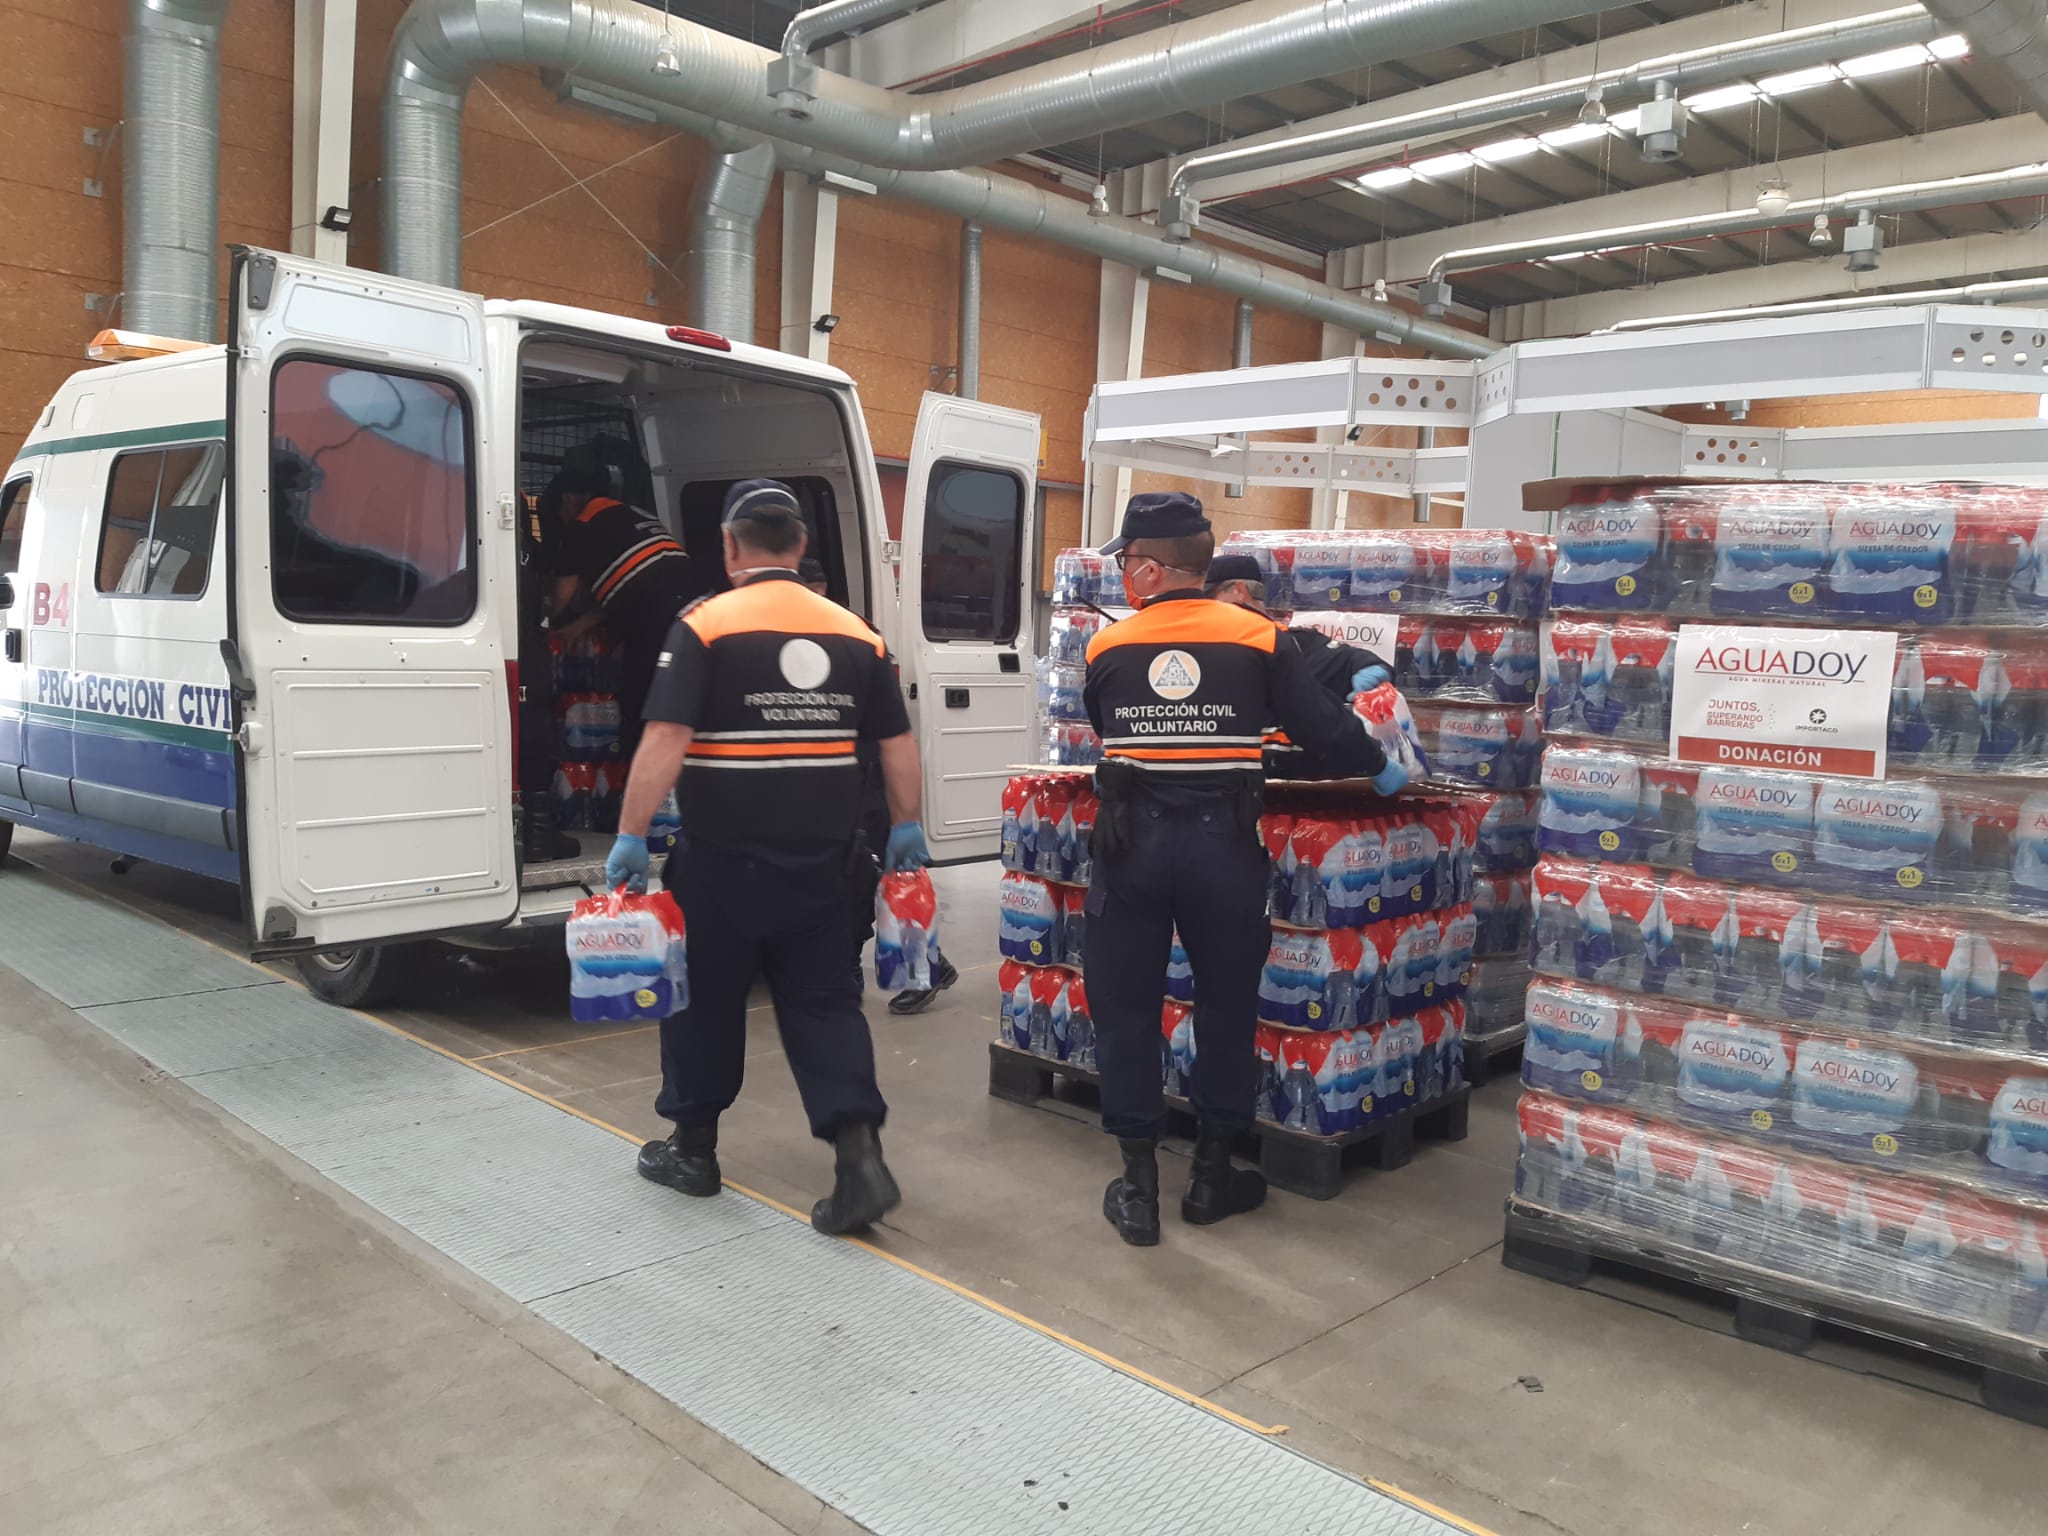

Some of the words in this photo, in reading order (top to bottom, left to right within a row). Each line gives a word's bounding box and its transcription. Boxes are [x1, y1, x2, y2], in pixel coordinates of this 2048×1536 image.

[1849, 520, 1942, 541] AGUADOY
[33, 582, 69, 627] B4
[1695, 647, 1868, 684] AGUADOY
[37, 669, 166, 721] PROTECCION
[178, 683, 232, 730] CIVI
[1115, 702, 1198, 719] PROTECCIÓN
[1202, 704, 1236, 717] CIVIL
[1130, 720, 1217, 733] VOLUNTARIO
[1707, 711, 1763, 723] SUPERANDO
[1707, 718, 1755, 730] BARRERAS
[1719, 744, 1822, 767] DONACIÓN
[1710, 783, 1797, 808] AGUADOY
[1833, 797, 1922, 823] AGUADOY
[1692, 1040, 1775, 1070] AGUADOY
[1810, 1060, 1899, 1092] AGUADOY
